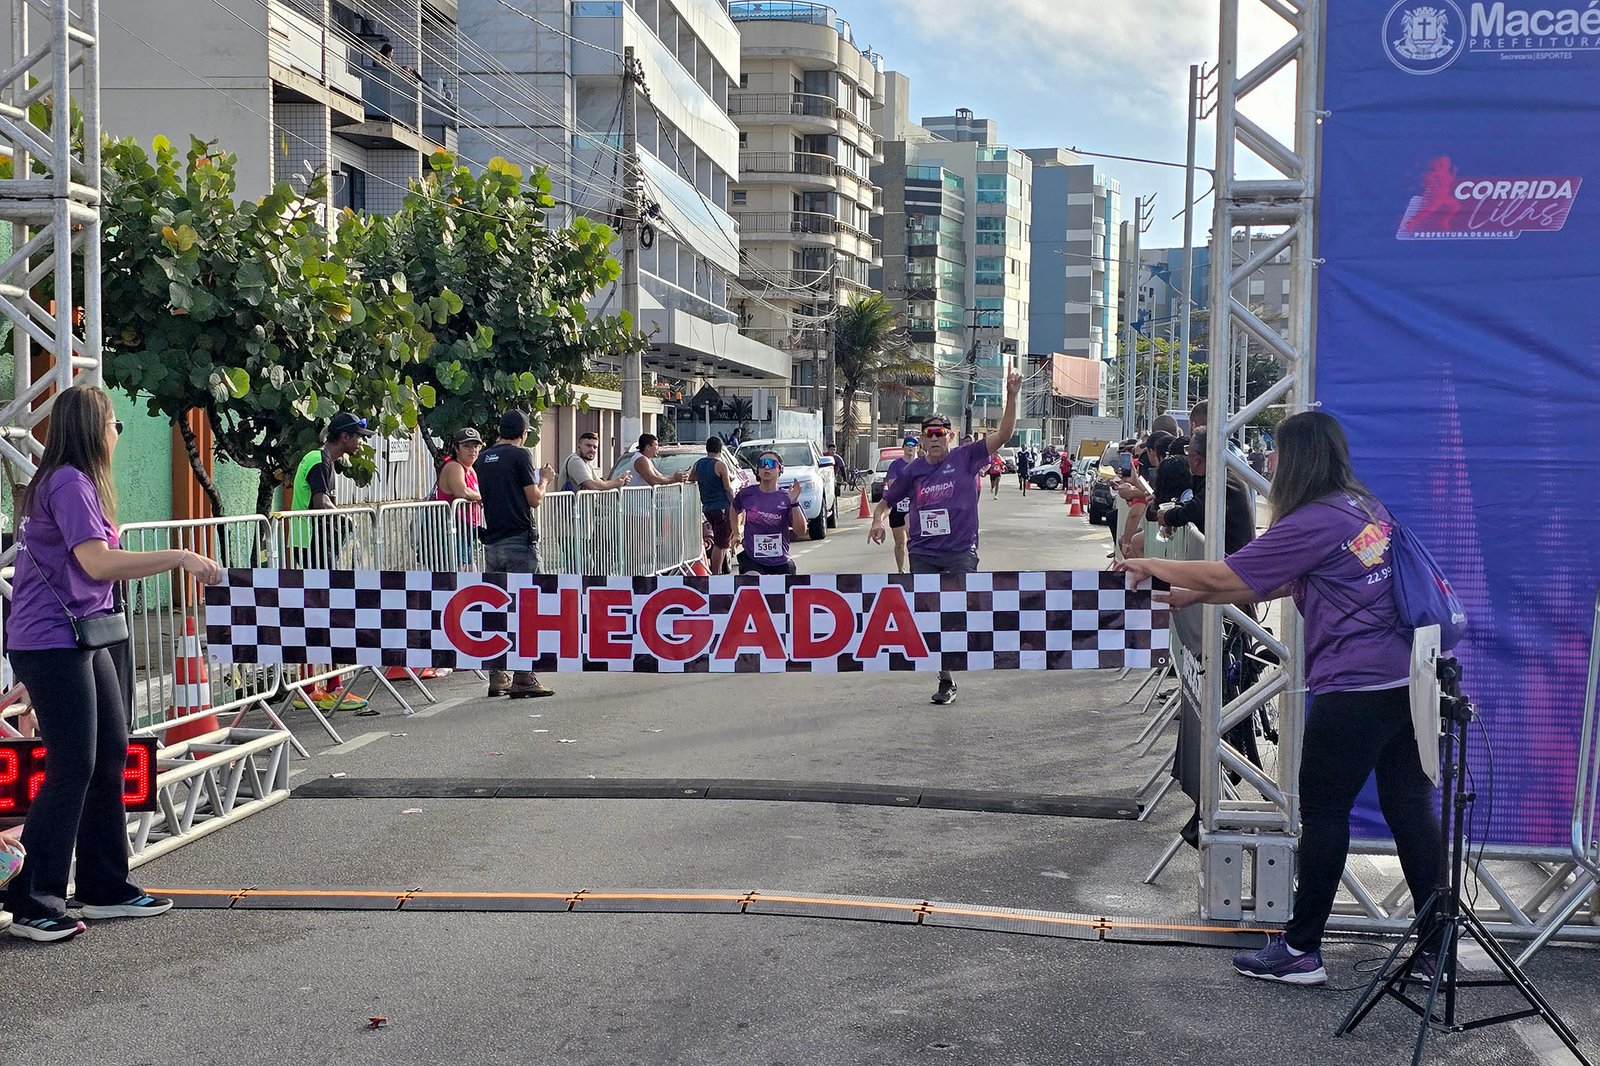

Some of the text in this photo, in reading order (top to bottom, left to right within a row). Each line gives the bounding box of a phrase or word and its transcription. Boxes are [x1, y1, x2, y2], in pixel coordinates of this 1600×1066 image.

[1470, 1, 1600, 37] Macaé
[1454, 180, 1573, 200] CORRIDA
[920, 481, 954, 495] CORRIDA
[926, 520, 939, 529] 176
[757, 543, 777, 551] 5364
[442, 584, 930, 661] CHEGADA
